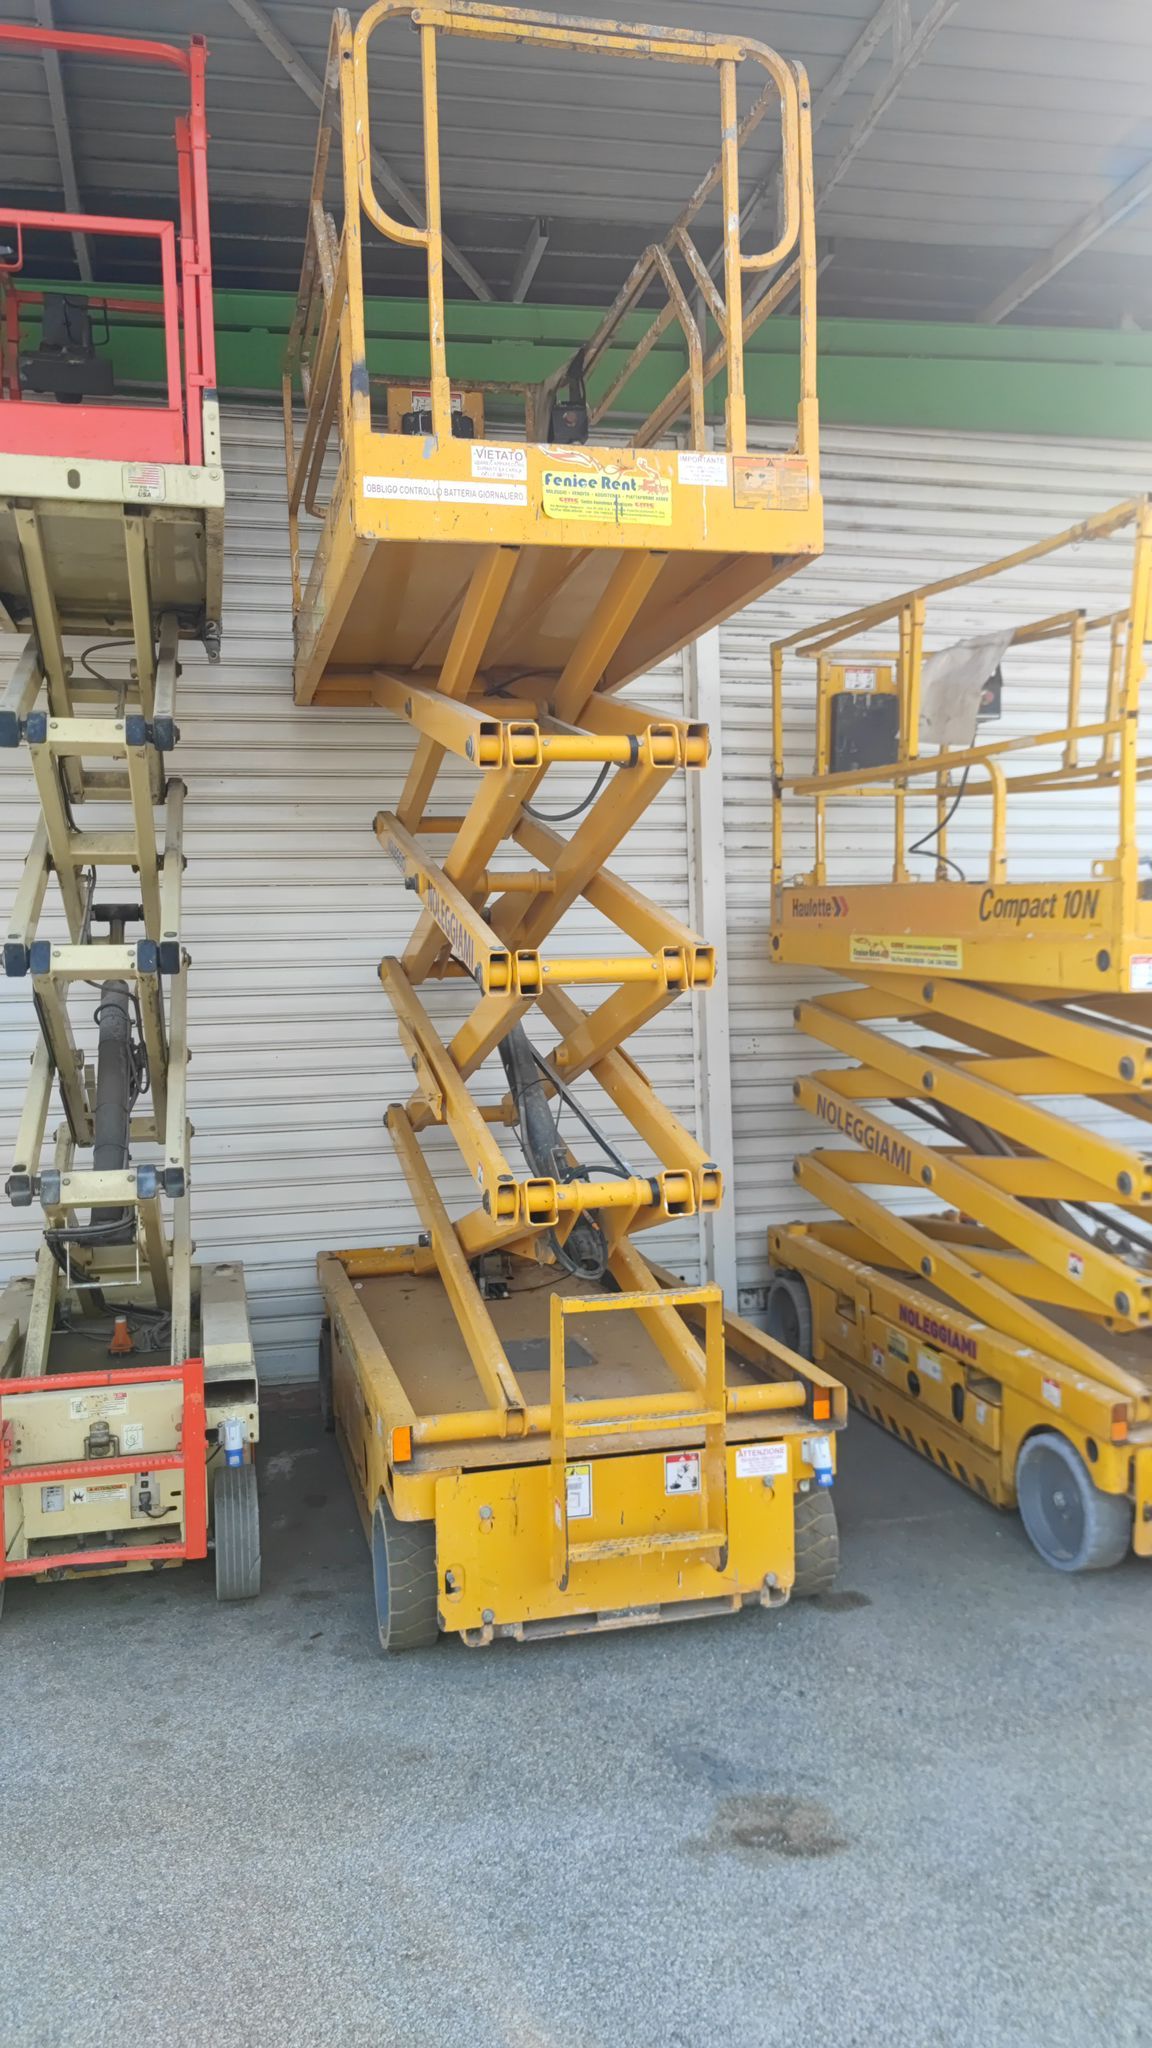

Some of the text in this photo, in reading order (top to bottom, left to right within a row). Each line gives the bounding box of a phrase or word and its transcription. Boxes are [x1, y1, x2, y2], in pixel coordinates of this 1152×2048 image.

[476, 448, 523, 461] VIETATO
[680, 455, 725, 465] IMPORTANTE
[545, 473, 597, 488] Fenice
[601, 476, 636, 491] Rent
[366, 483, 524, 501] OBBLIGO CONTROLLO BATTERIA GIORNALIERO
[792, 898, 831, 917] Haulotte
[979, 888, 1100, 927] Compact 10N
[427, 880, 474, 973] NOLEGGIAMI
[817, 1093, 911, 1174] NOLEGGIAMI
[899, 1303, 977, 1360] NOLEGGIAMI
[738, 1447, 785, 1457] ATTENZIONE
